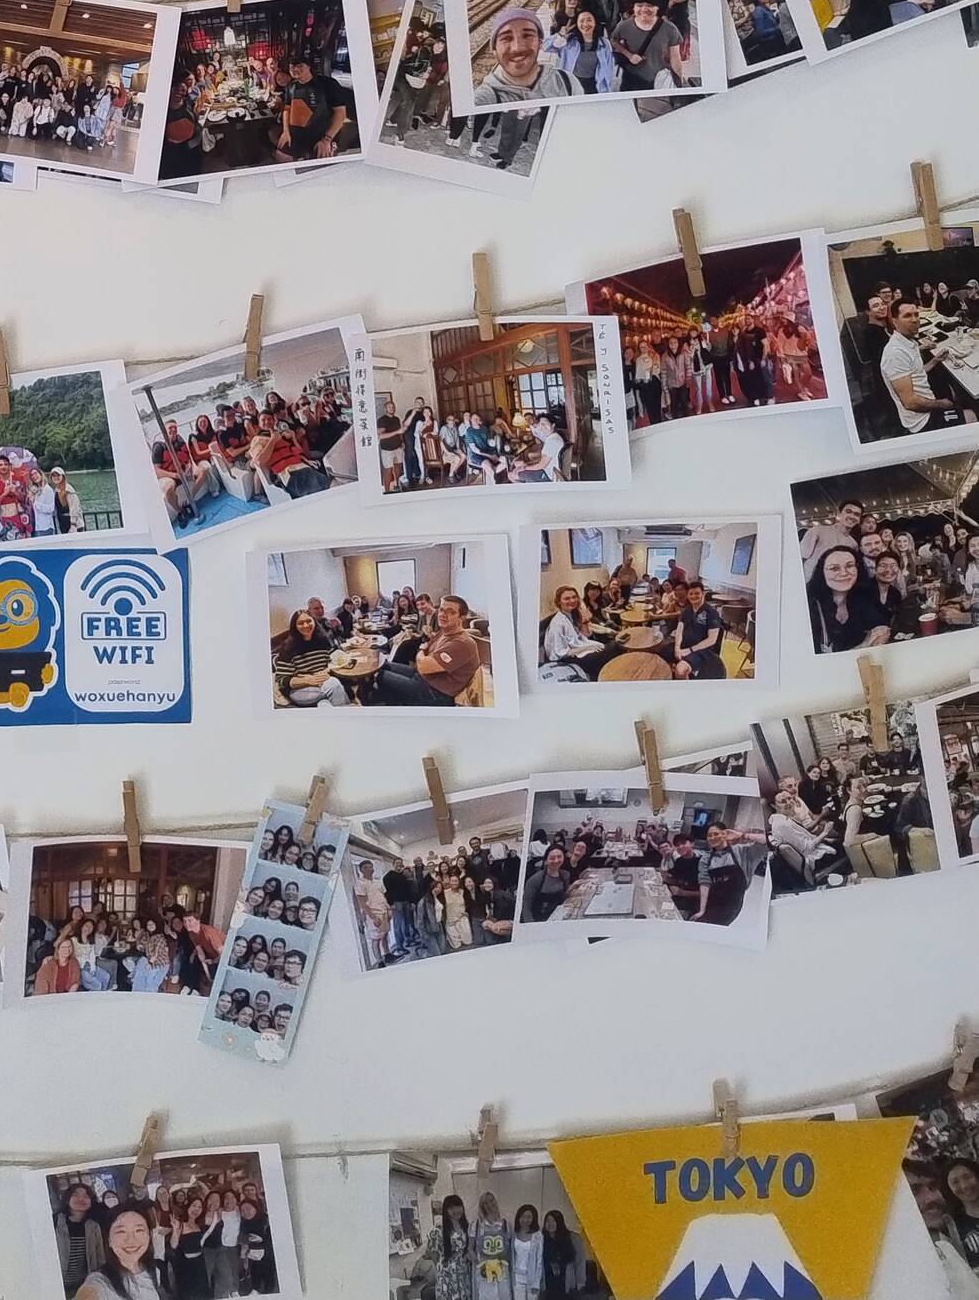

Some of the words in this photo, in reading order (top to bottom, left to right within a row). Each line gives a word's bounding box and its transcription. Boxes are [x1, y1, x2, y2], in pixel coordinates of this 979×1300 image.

[87, 616, 161, 637] FREE
[93, 645, 155, 665] WIFI
[74, 690, 176, 705] woxuehanyu
[644, 1152, 815, 1205] TOKYO
